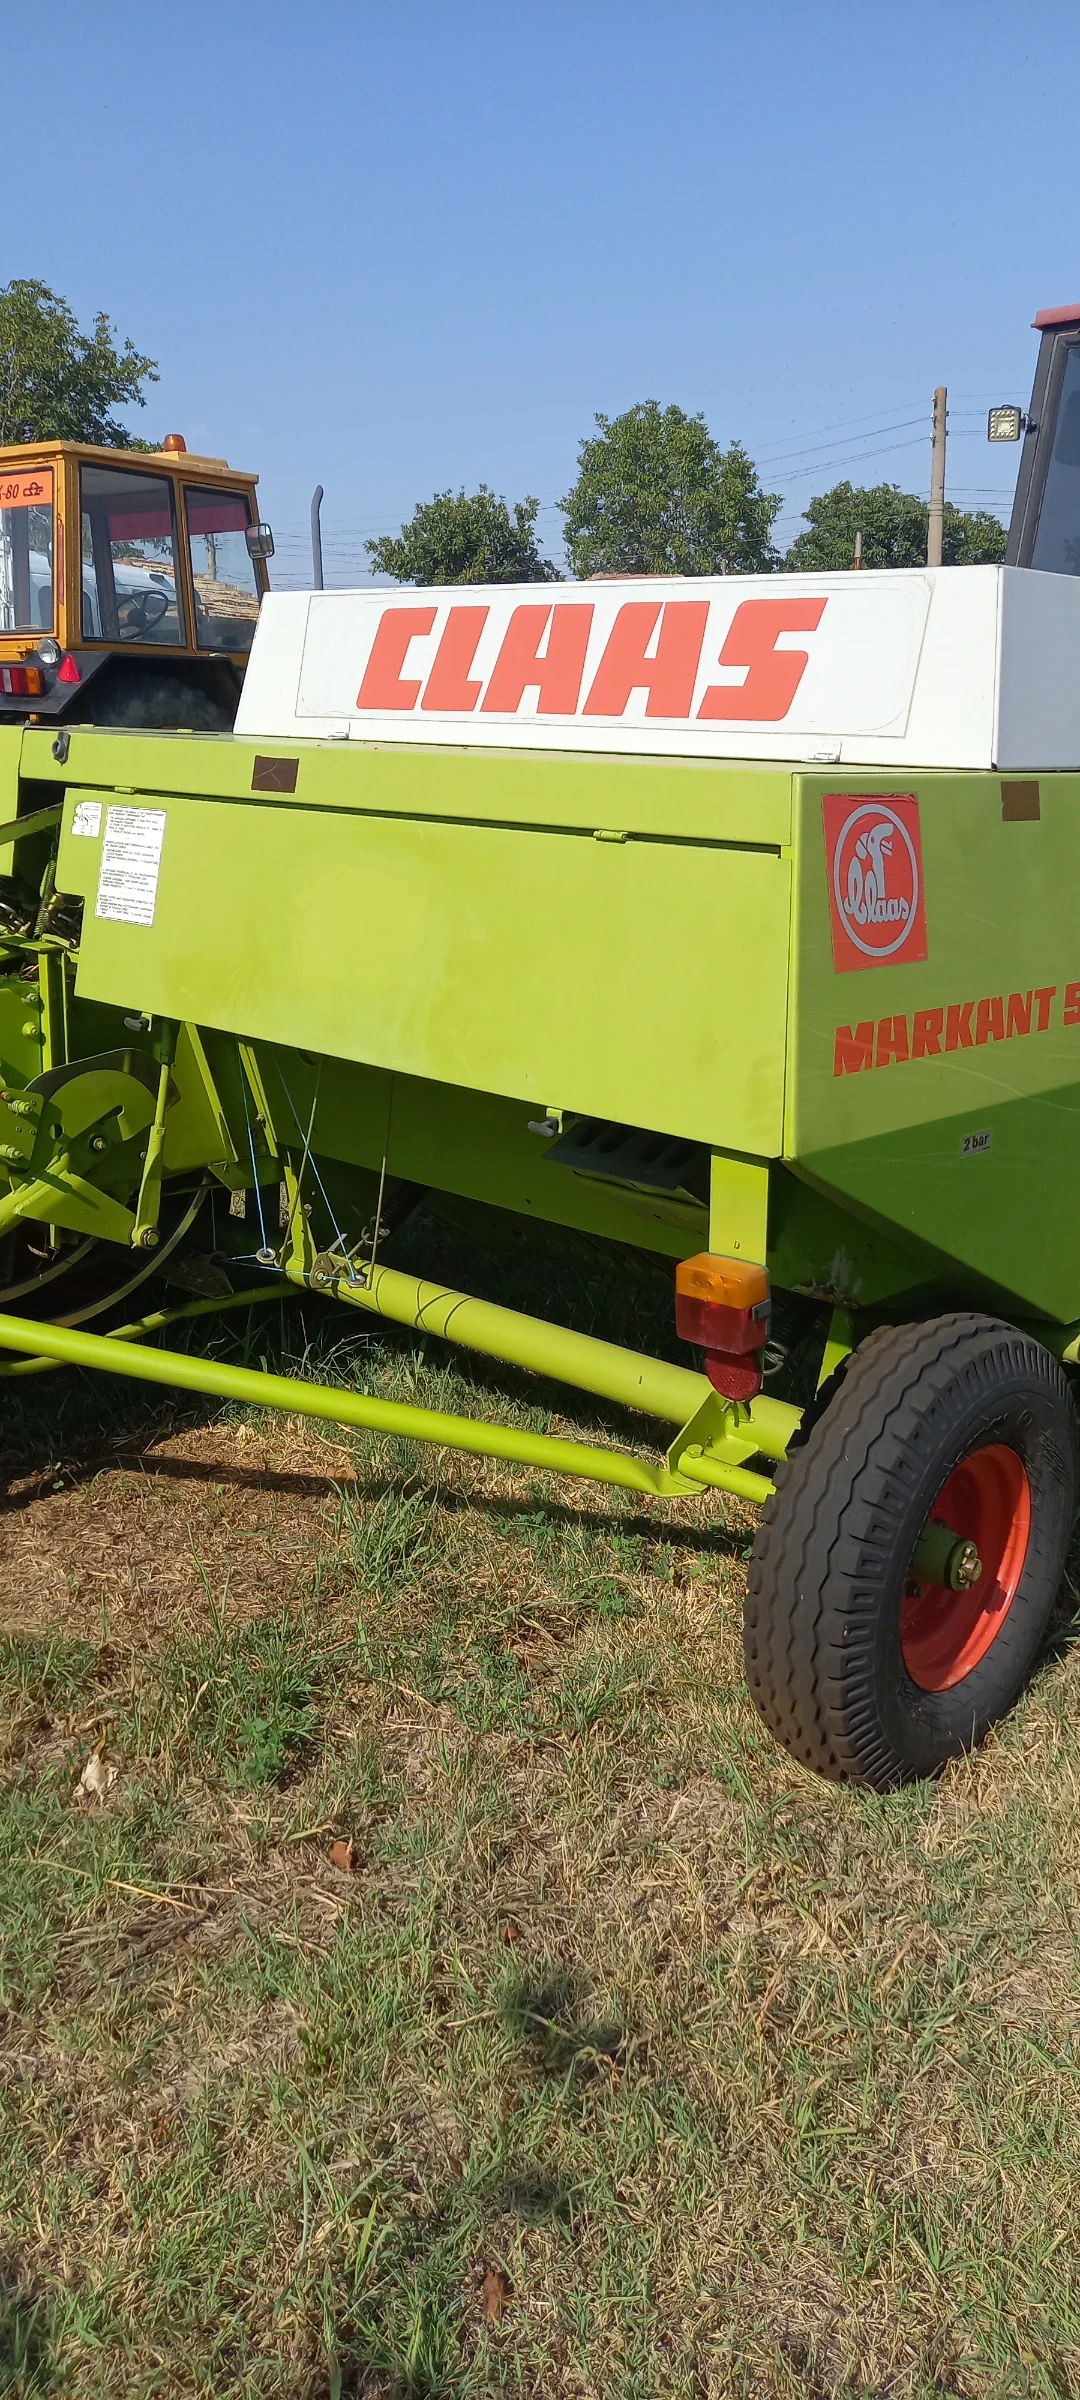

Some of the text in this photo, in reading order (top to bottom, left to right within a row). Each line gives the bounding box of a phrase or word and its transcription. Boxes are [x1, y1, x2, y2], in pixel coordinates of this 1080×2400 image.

[356, 597, 829, 721] CLAAS
[833, 986, 1057, 1077] MARKANT
[963, 1134, 990, 1152] 2 bar
